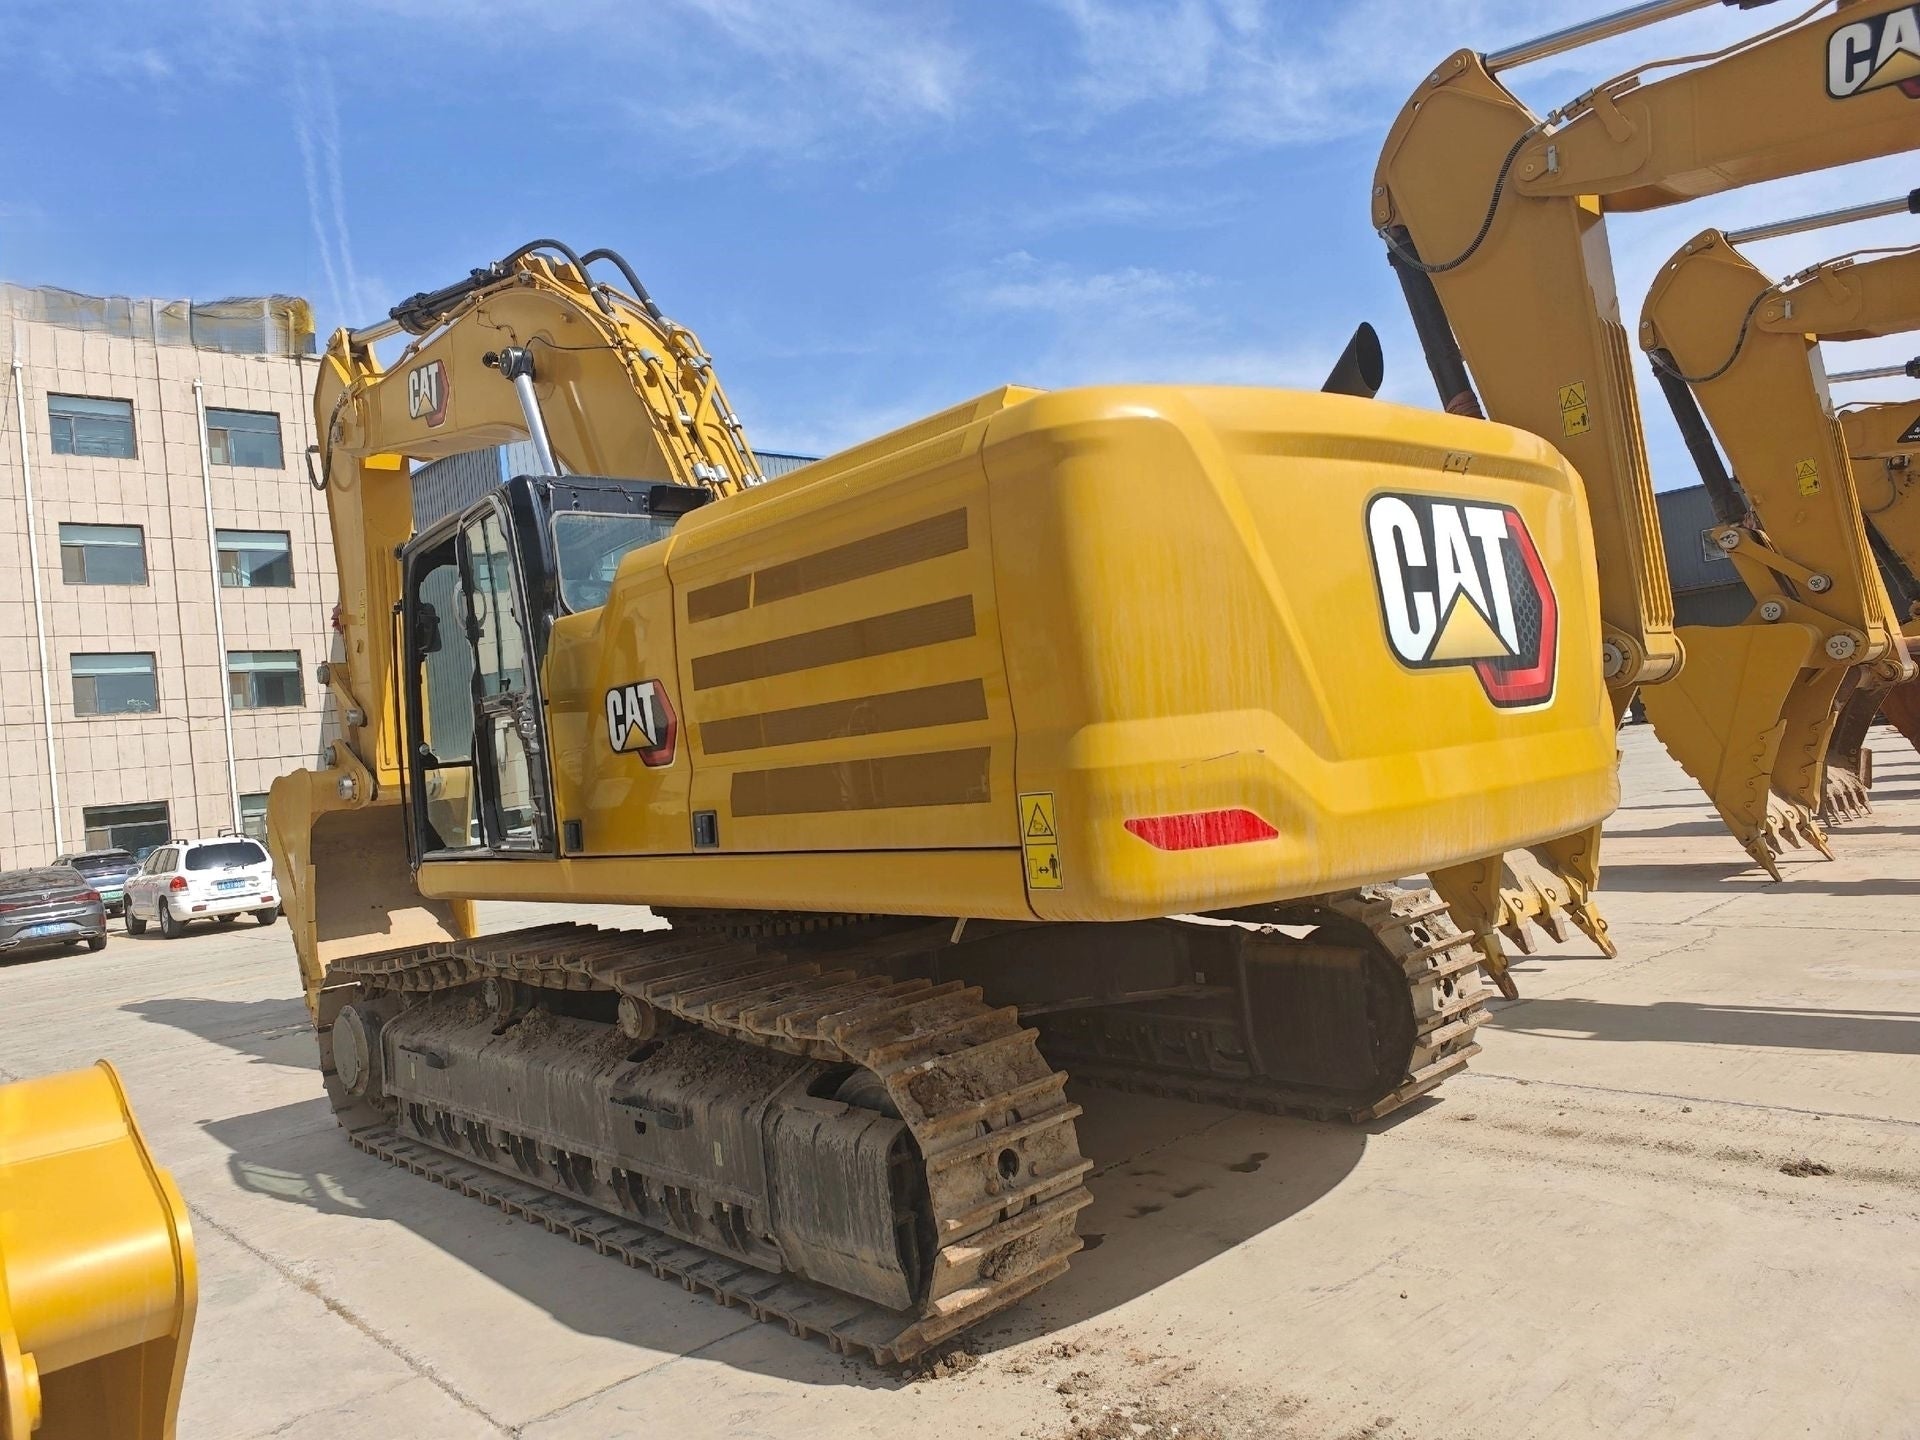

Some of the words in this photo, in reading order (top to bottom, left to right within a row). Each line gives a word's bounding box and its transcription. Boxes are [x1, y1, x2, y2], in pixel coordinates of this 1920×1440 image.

[409, 362, 439, 418] CAT
[1369, 497, 1520, 661] CAT
[606, 682, 657, 751] CAT
